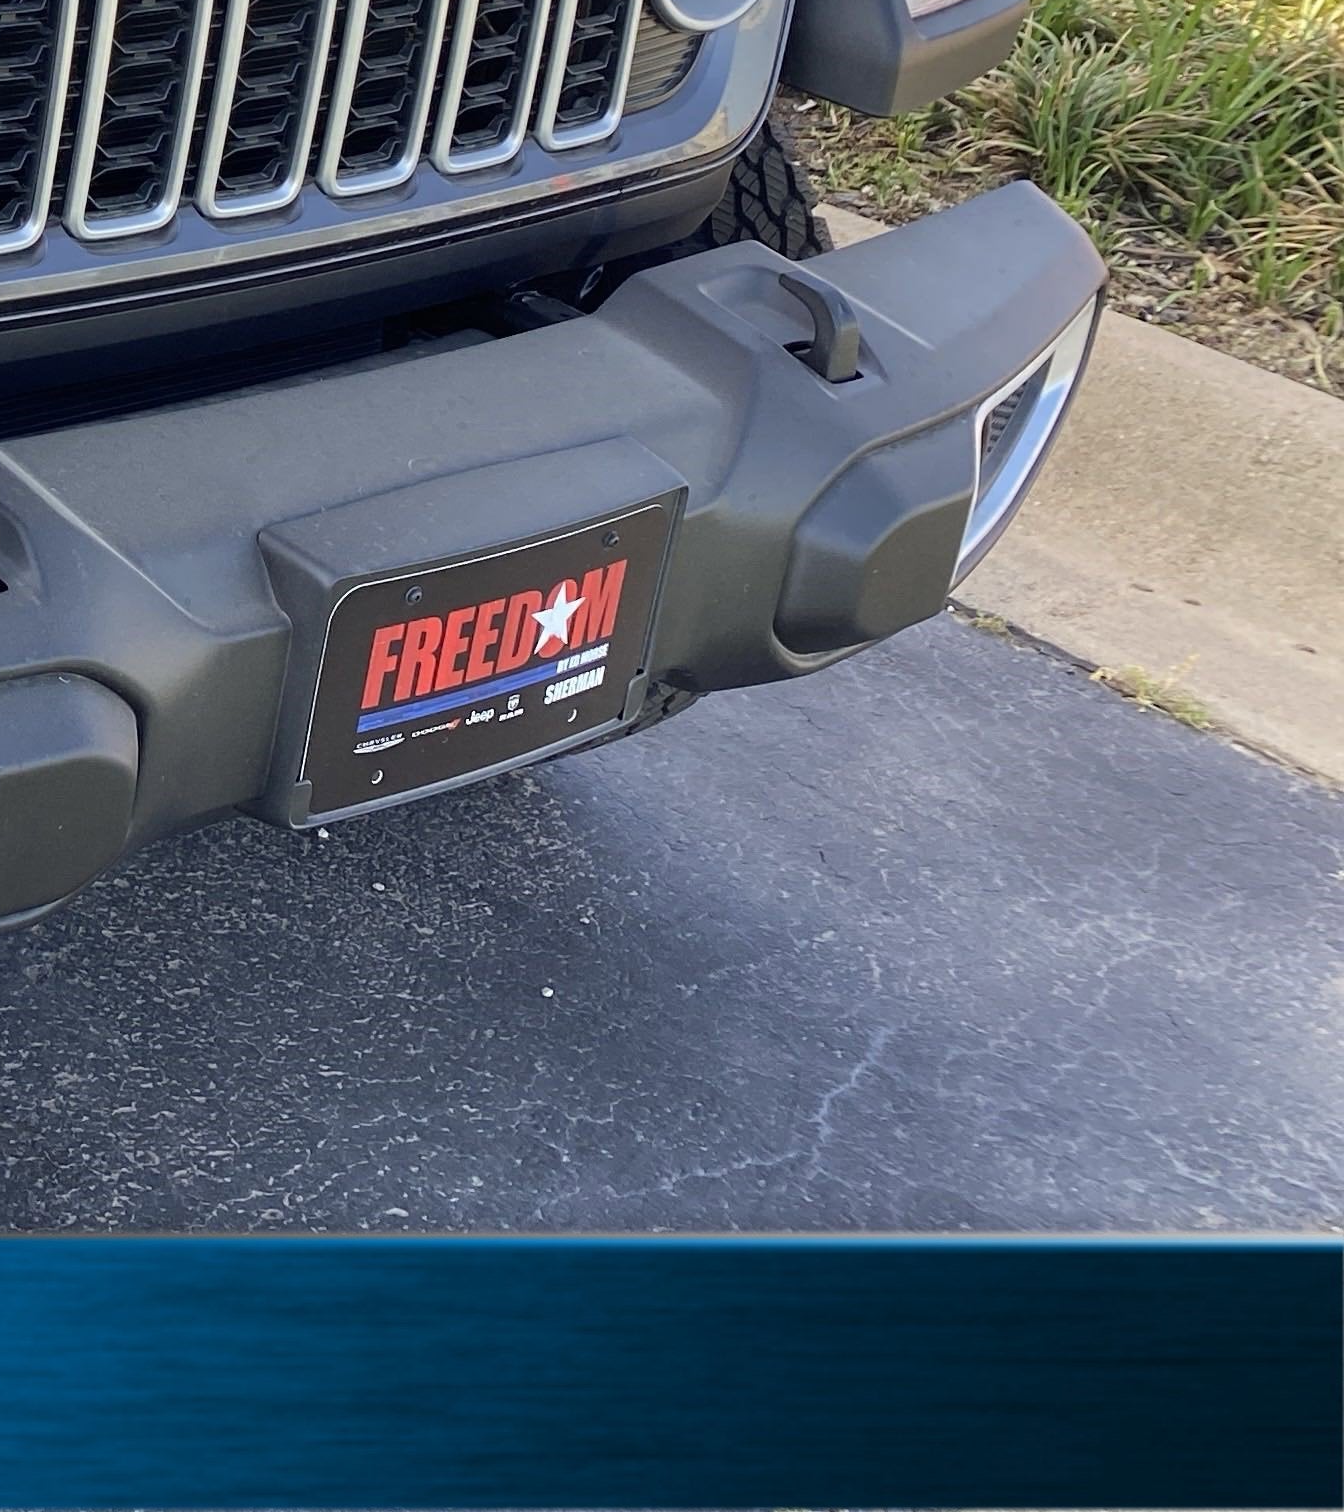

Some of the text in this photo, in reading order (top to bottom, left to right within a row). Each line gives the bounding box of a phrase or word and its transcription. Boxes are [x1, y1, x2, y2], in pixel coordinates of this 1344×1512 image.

[361, 559, 629, 710] FREEDOM
[356, 665, 606, 749] CHRYSLER DODGE Jeep RAM SHERMAN
